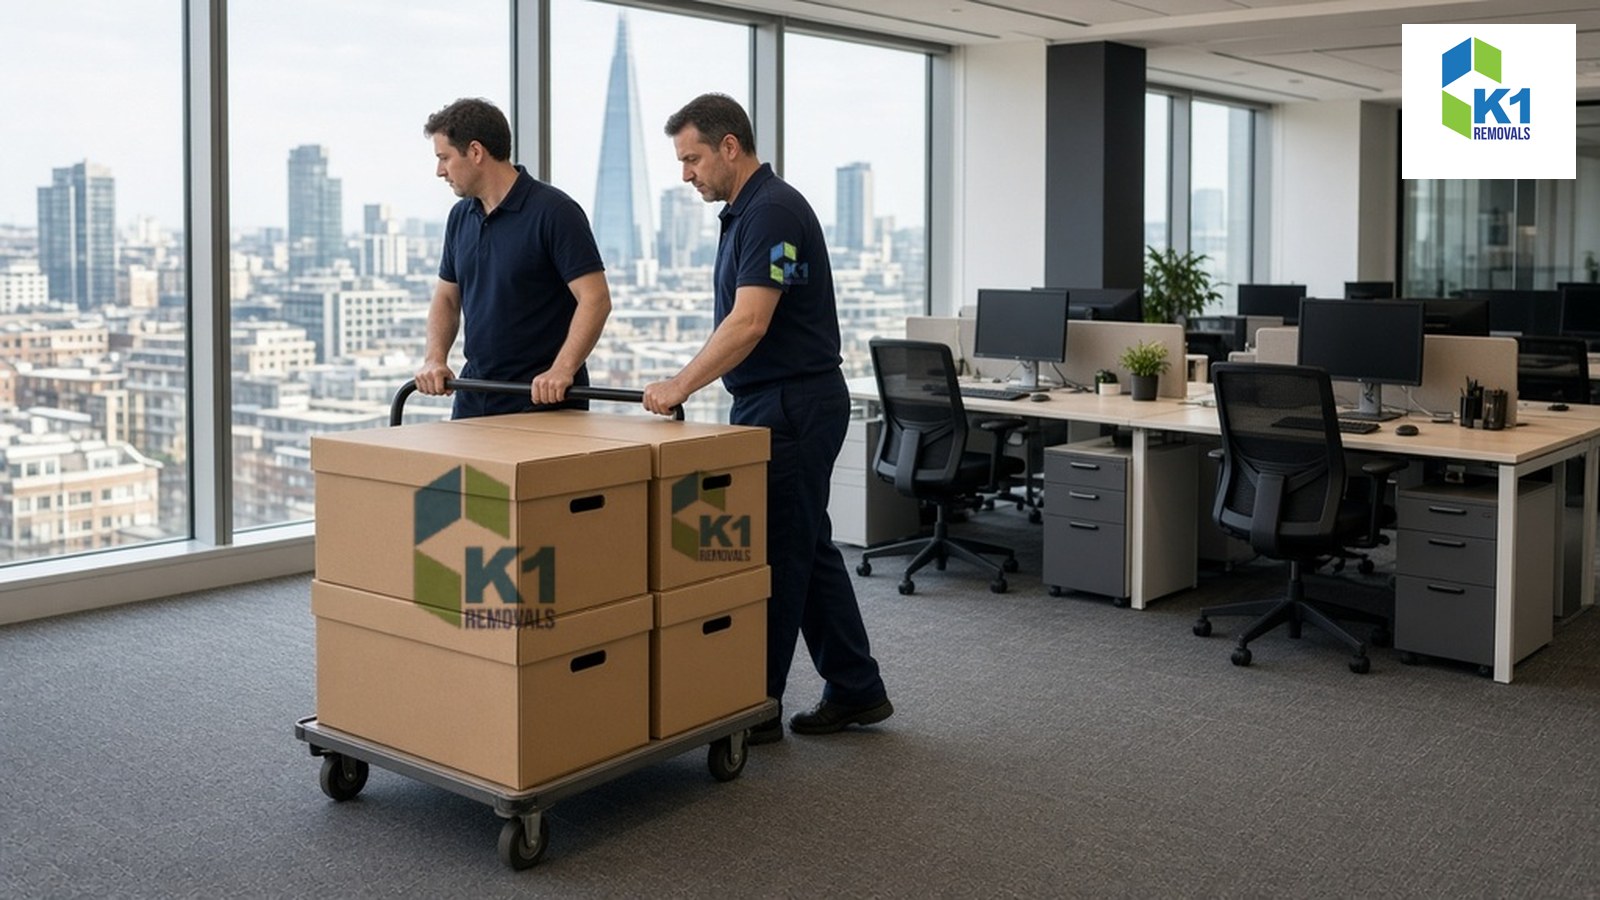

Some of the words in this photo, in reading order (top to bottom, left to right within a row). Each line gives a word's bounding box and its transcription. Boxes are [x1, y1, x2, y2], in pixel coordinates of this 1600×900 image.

[784, 262, 809, 278] K1
[700, 515, 751, 547] K1
[700, 549, 751, 562] REMOVALS
[465, 546, 556, 604] K1
[465, 608, 556, 630] REMOVALS
